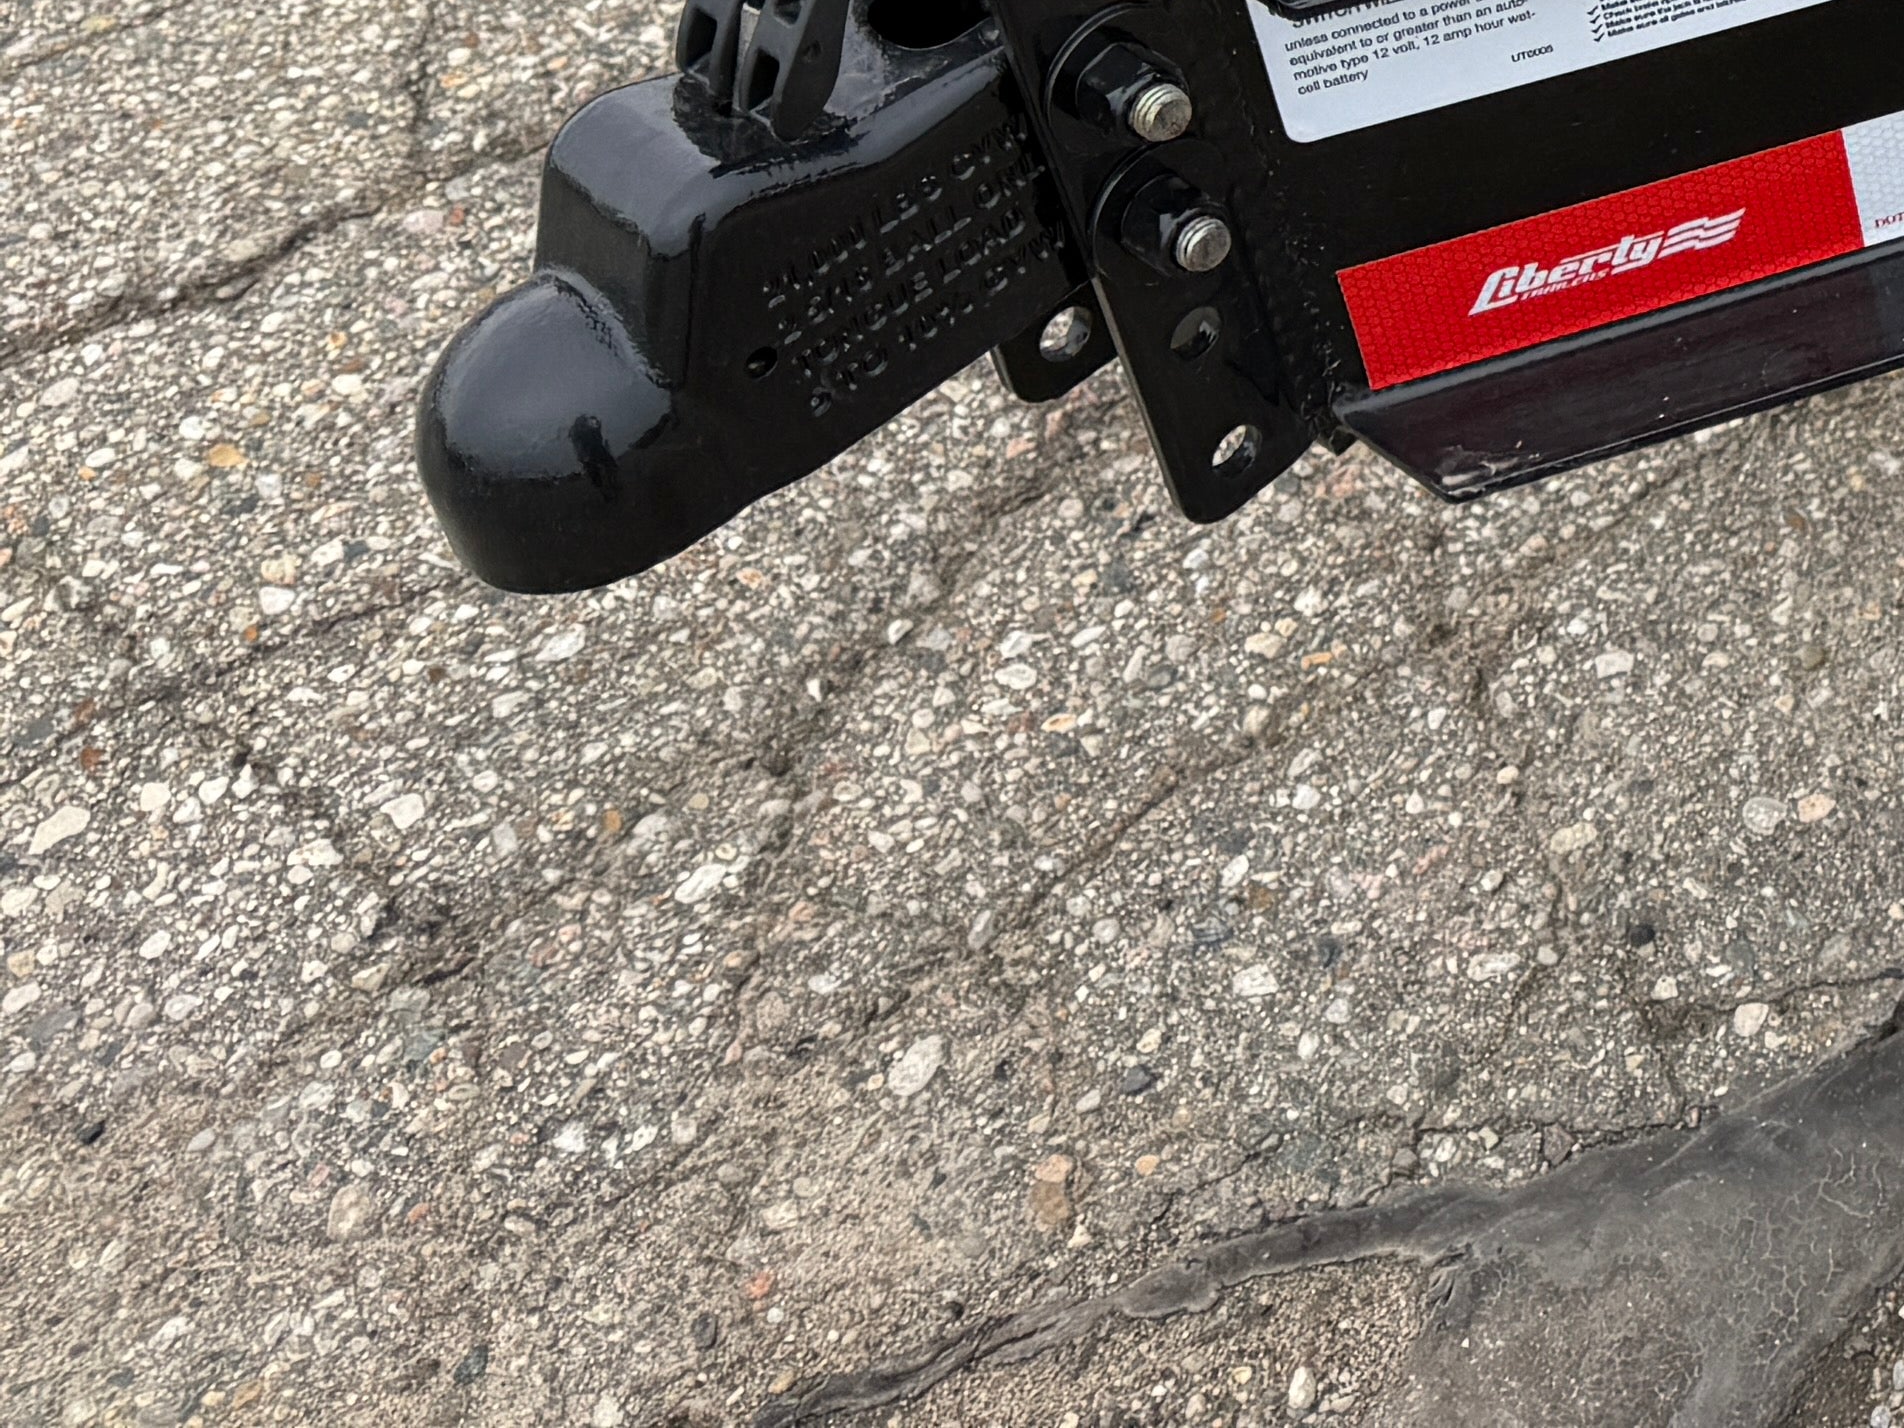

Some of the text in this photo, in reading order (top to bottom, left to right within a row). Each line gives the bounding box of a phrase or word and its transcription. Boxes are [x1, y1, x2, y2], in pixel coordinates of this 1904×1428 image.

[1284, 32, 1328, 53] unless
[1331, 13, 1400, 41] connected
[1402, 9, 1415, 22] to
[1420, 7, 1428, 17] a
[1289, 40, 1357, 68] equivalent
[1359, 36, 1372, 49] to
[1376, 33, 1388, 45] or
[1393, 19, 1438, 42] greater
[1442, 9, 1471, 27] than
[1475, 6, 1491, 18] an
[1294, 59, 1338, 81] motive
[1340, 51, 1368, 71] type
[1372, 46, 1389, 61] 12
[1423, 33, 1440, 47] 12
[1444, 26, 1472, 43] amp
[1474, 16, 1504, 34] hour
[1323, 68, 1368, 91] battery
[1468, 230, 1665, 317] Liberty
